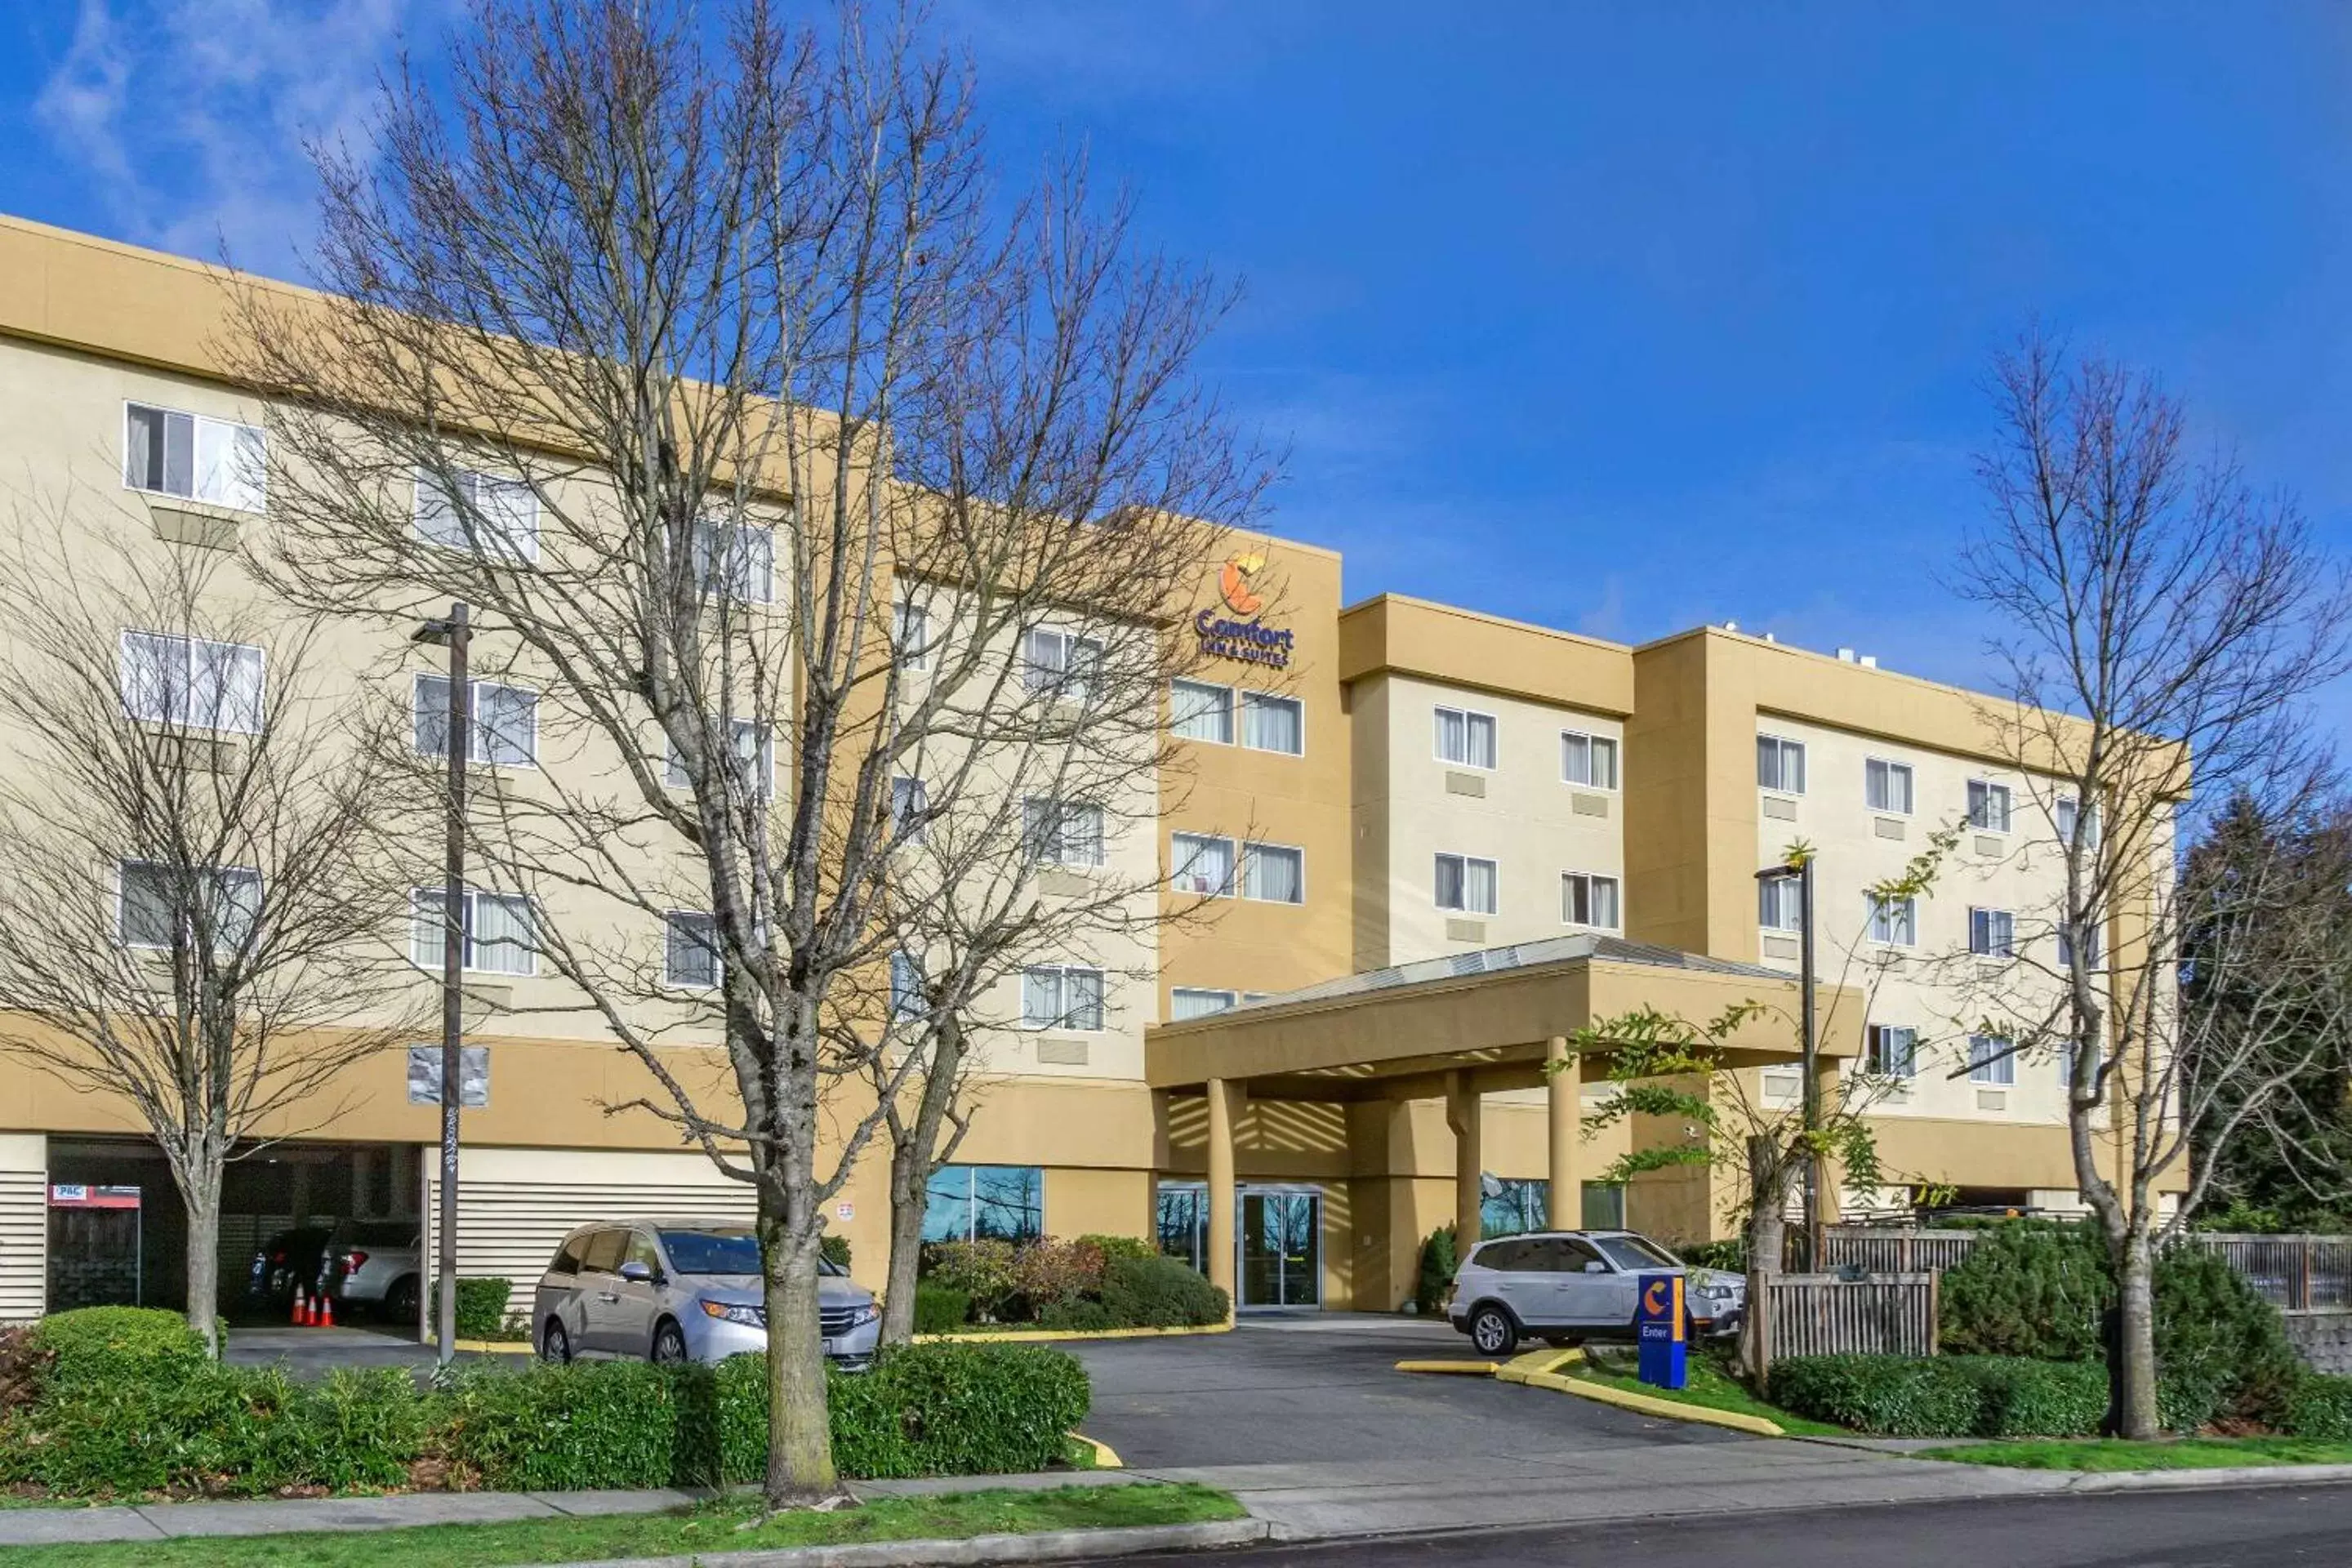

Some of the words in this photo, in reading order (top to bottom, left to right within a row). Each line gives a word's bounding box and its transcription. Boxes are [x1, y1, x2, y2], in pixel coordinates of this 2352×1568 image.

[1196, 609, 1294, 649] Comfort
[1242, 648, 1288, 666] SUITES
[1642, 1325, 1668, 1338] Enter
